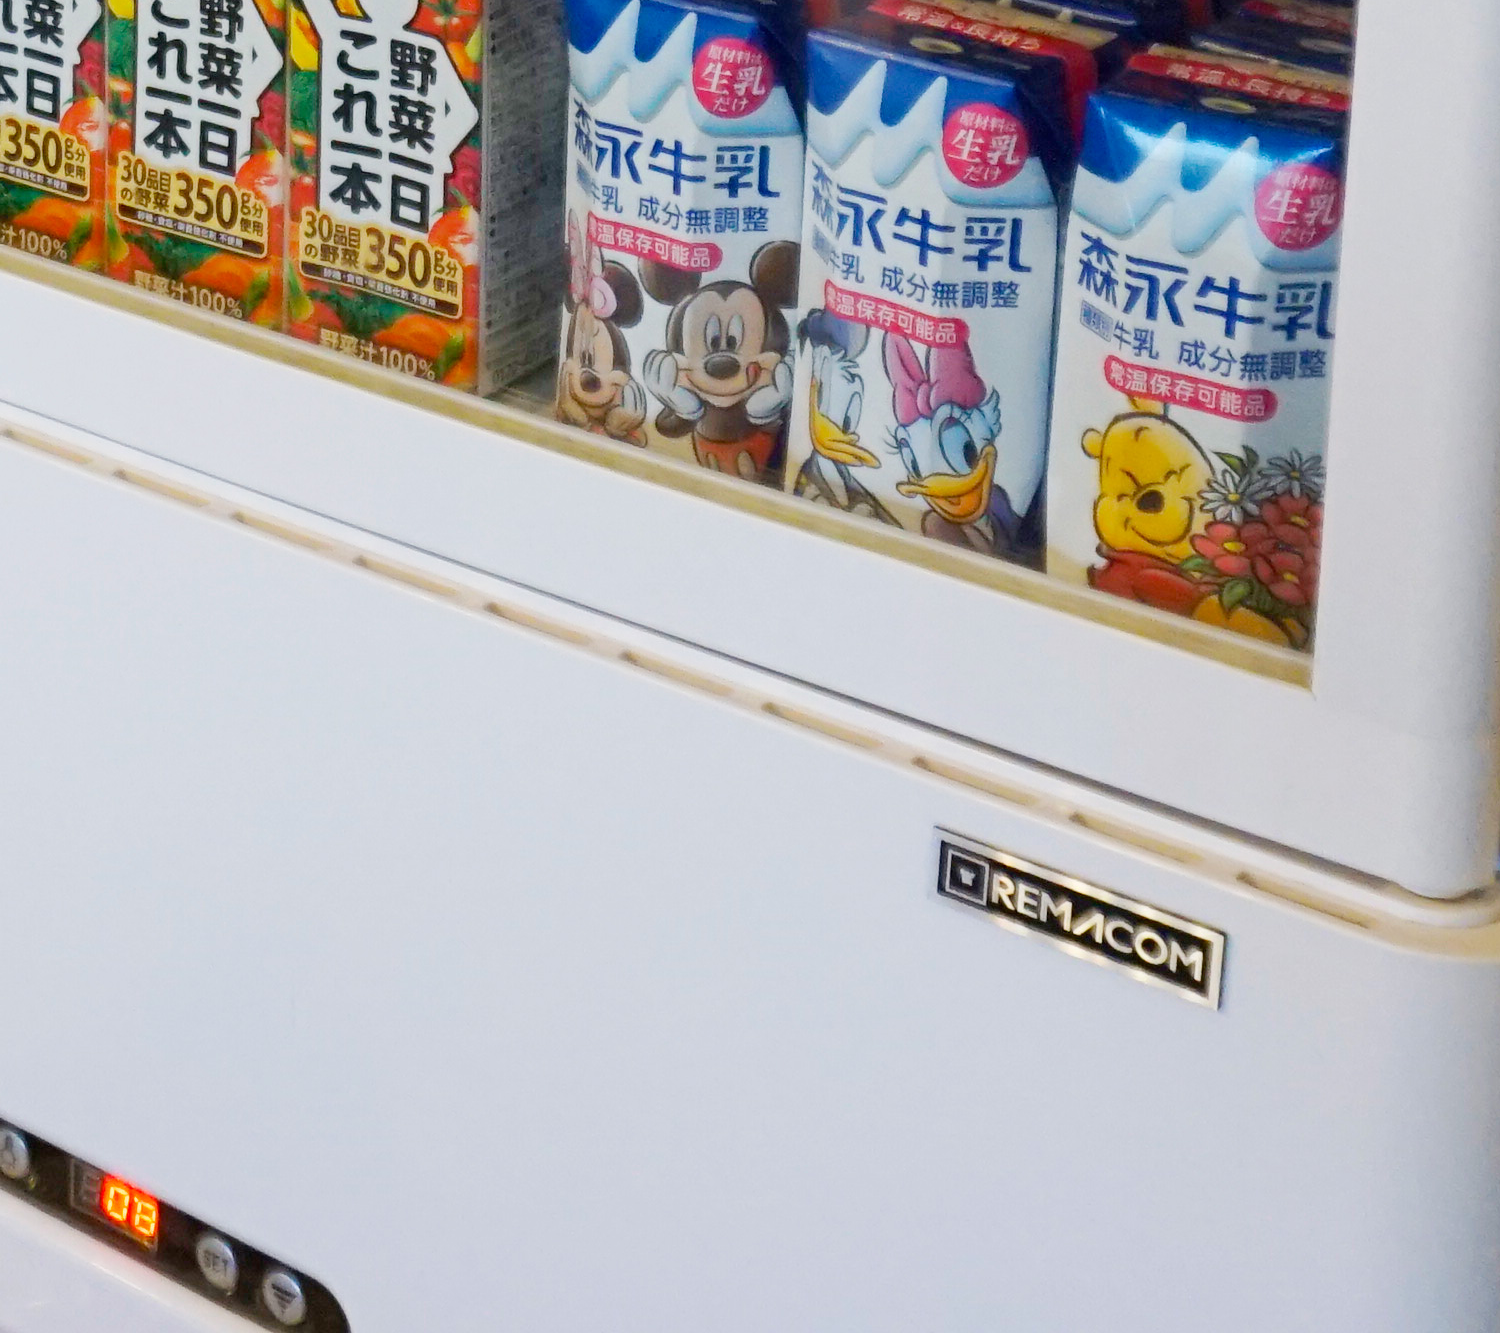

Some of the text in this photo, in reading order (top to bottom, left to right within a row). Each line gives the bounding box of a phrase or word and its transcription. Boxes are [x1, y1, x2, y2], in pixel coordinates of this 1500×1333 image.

[696, 61, 767, 97] 生乳
[329, 29, 384, 215] これ一本
[712, 94, 750, 113] だけ
[388, 39, 437, 234] 野菜一日
[573, 97, 781, 200] 森永牛乳
[947, 129, 1022, 166] 生乳
[63, 163, 87, 182] 使用
[120, 155, 172, 193] 30品目
[962, 164, 1002, 182] だけ
[120, 186, 170, 214] の野菜
[637, 195, 770, 234] 成分無調整
[811, 159, 1032, 273] 森永牛乳
[1261, 188, 1338, 226] 生乳
[239, 217, 264, 238] 使用
[303, 210, 361, 250] 30品目
[304, 243, 361, 269] の野菜
[433, 275, 459, 298] 使用
[880, 265, 1020, 309] 成分無調整
[1077, 230, 1336, 342] 森永牛乳
[1113, 318, 1161, 362] 牛乳
[1177, 339, 1327, 382] 成分無調整
[1108, 359, 1267, 418] 常温保存可能品
[991, 872, 1204, 982] REMACOM
